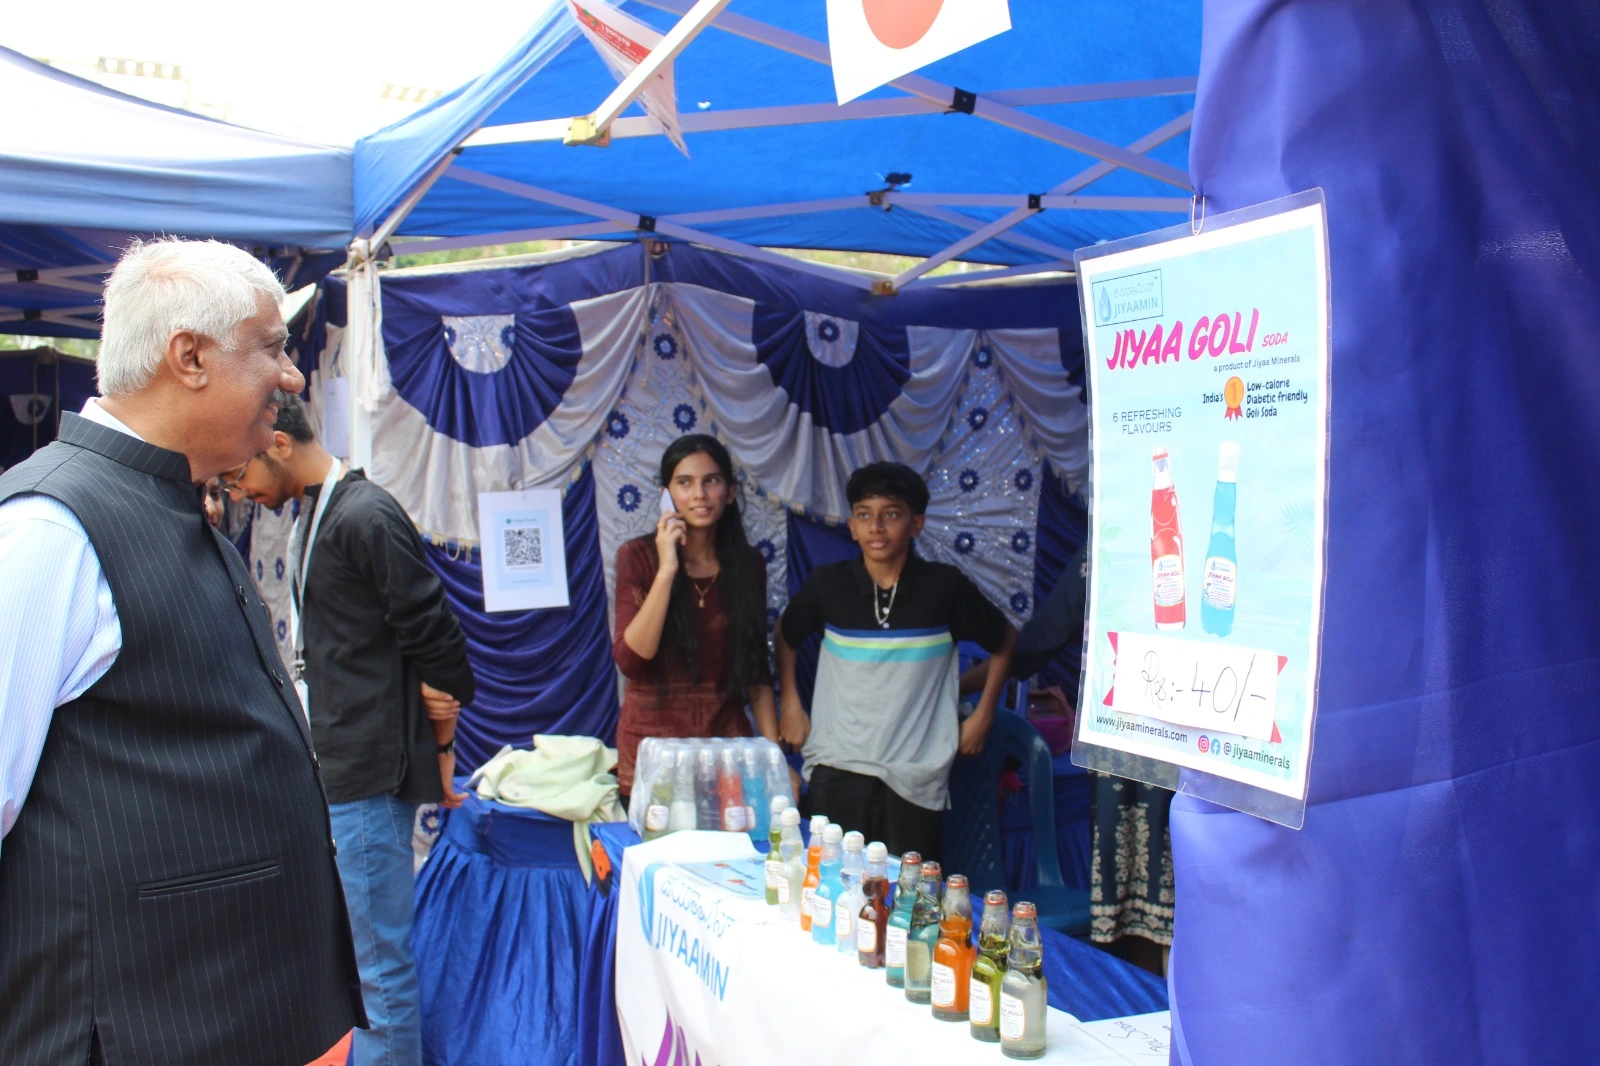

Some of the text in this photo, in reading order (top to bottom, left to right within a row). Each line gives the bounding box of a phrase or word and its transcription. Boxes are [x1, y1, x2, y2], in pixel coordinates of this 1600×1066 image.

[1113, 296, 1158, 318] JIYAAMIN
[1106, 308, 1289, 371] JIYAA GOLI SODA
[1218, 362, 1244, 373] product
[1244, 359, 1252, 369] of
[1252, 358, 1270, 369] Jiyaa
[1271, 354, 1301, 366] Minerals
[1202, 381, 1237, 404] India's 1
[1246, 378, 1290, 392] Low-calorie
[1246, 389, 1308, 405] Diabetic friendly
[1112, 406, 1182, 422] 6 REFRESHING
[1246, 405, 1278, 419] Goli Soda
[1122, 421, 1172, 435] FLAVOURS
[1096, 714, 1188, 743] www.jiyaaminerals.com
[1232, 743, 1290, 770] jiyaaminerals
[655, 913, 730, 1002] JIYAAMIN
